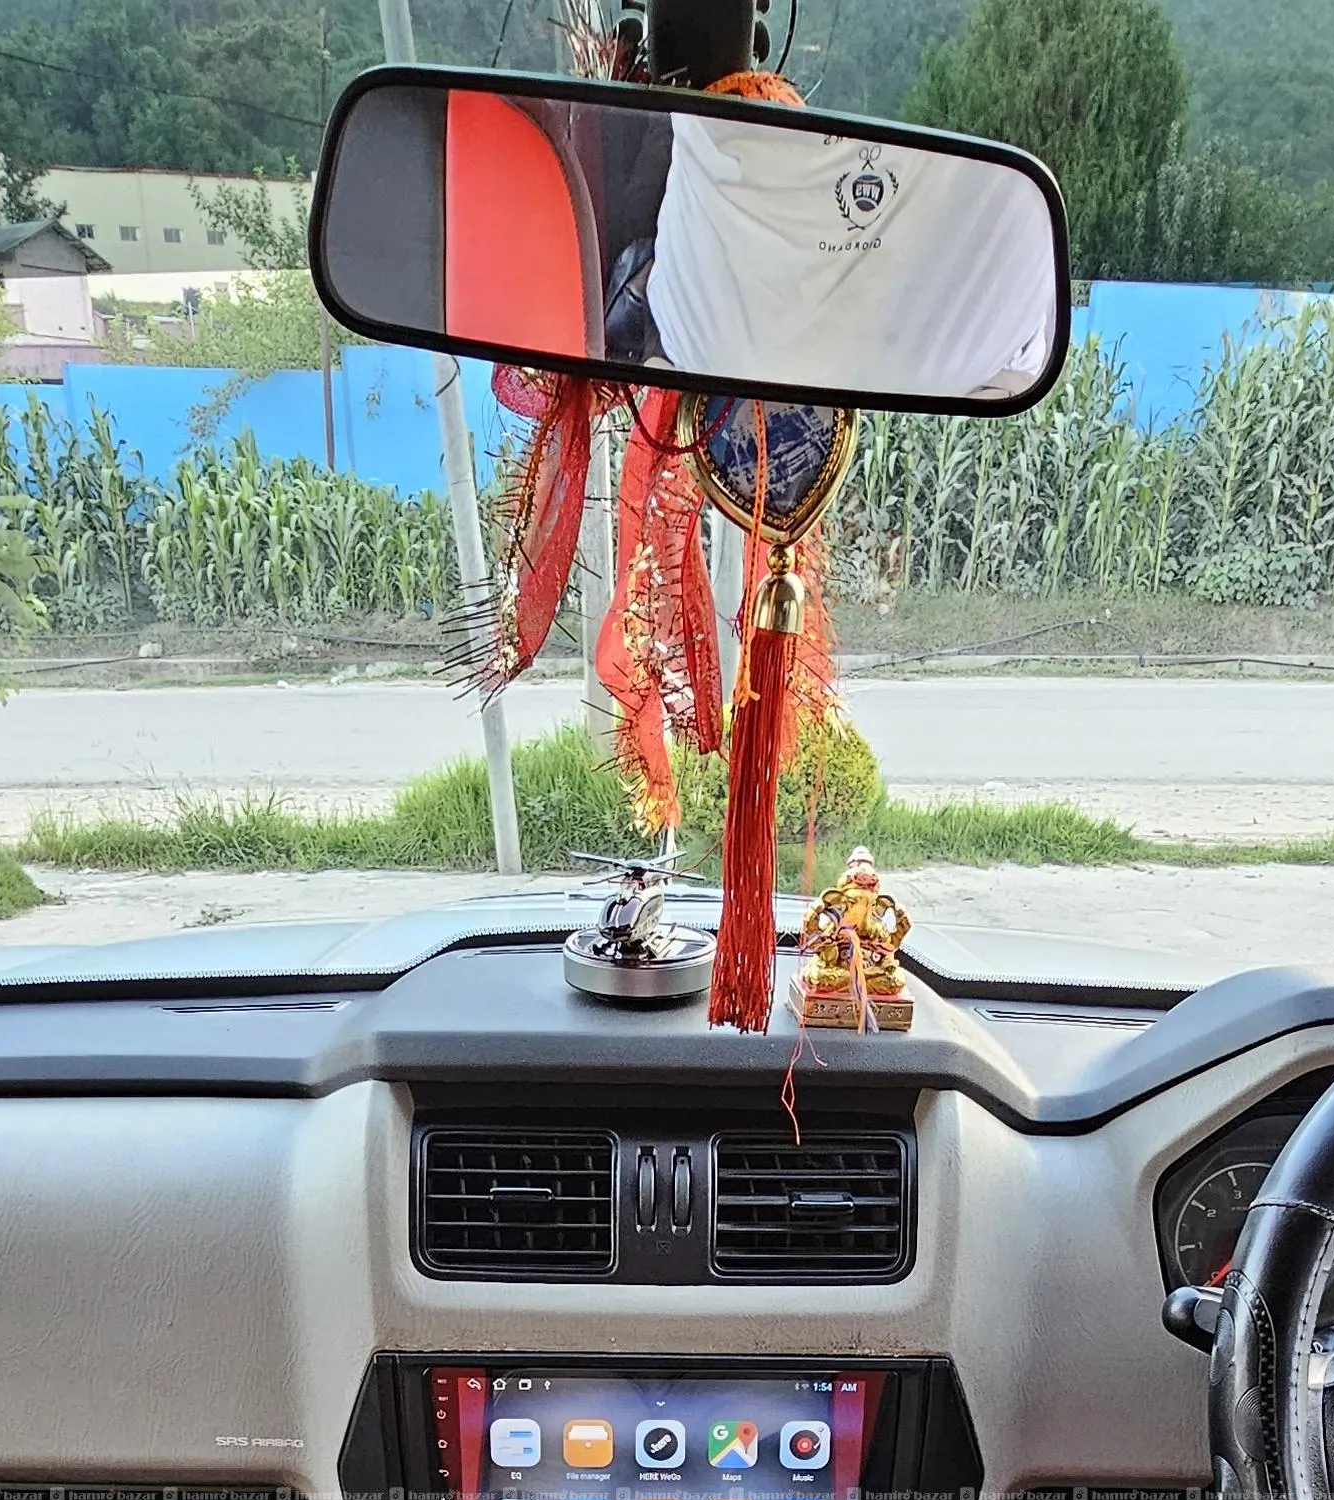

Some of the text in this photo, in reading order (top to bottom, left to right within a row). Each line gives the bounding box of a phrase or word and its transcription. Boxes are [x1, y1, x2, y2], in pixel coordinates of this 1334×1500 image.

[1234, 1190, 1242, 1199] 3
[1207, 1209, 1217, 1218] 2
[813, 1382, 857, 1392] 1:54 AM
[216, 1436, 304, 1448] SRS AIRBAG
[510, 1472, 522, 1480] EQ
[580, 1473, 611, 1482] manager
[722, 1473, 742, 1482] Maps
[793, 1473, 814, 1482] Music
